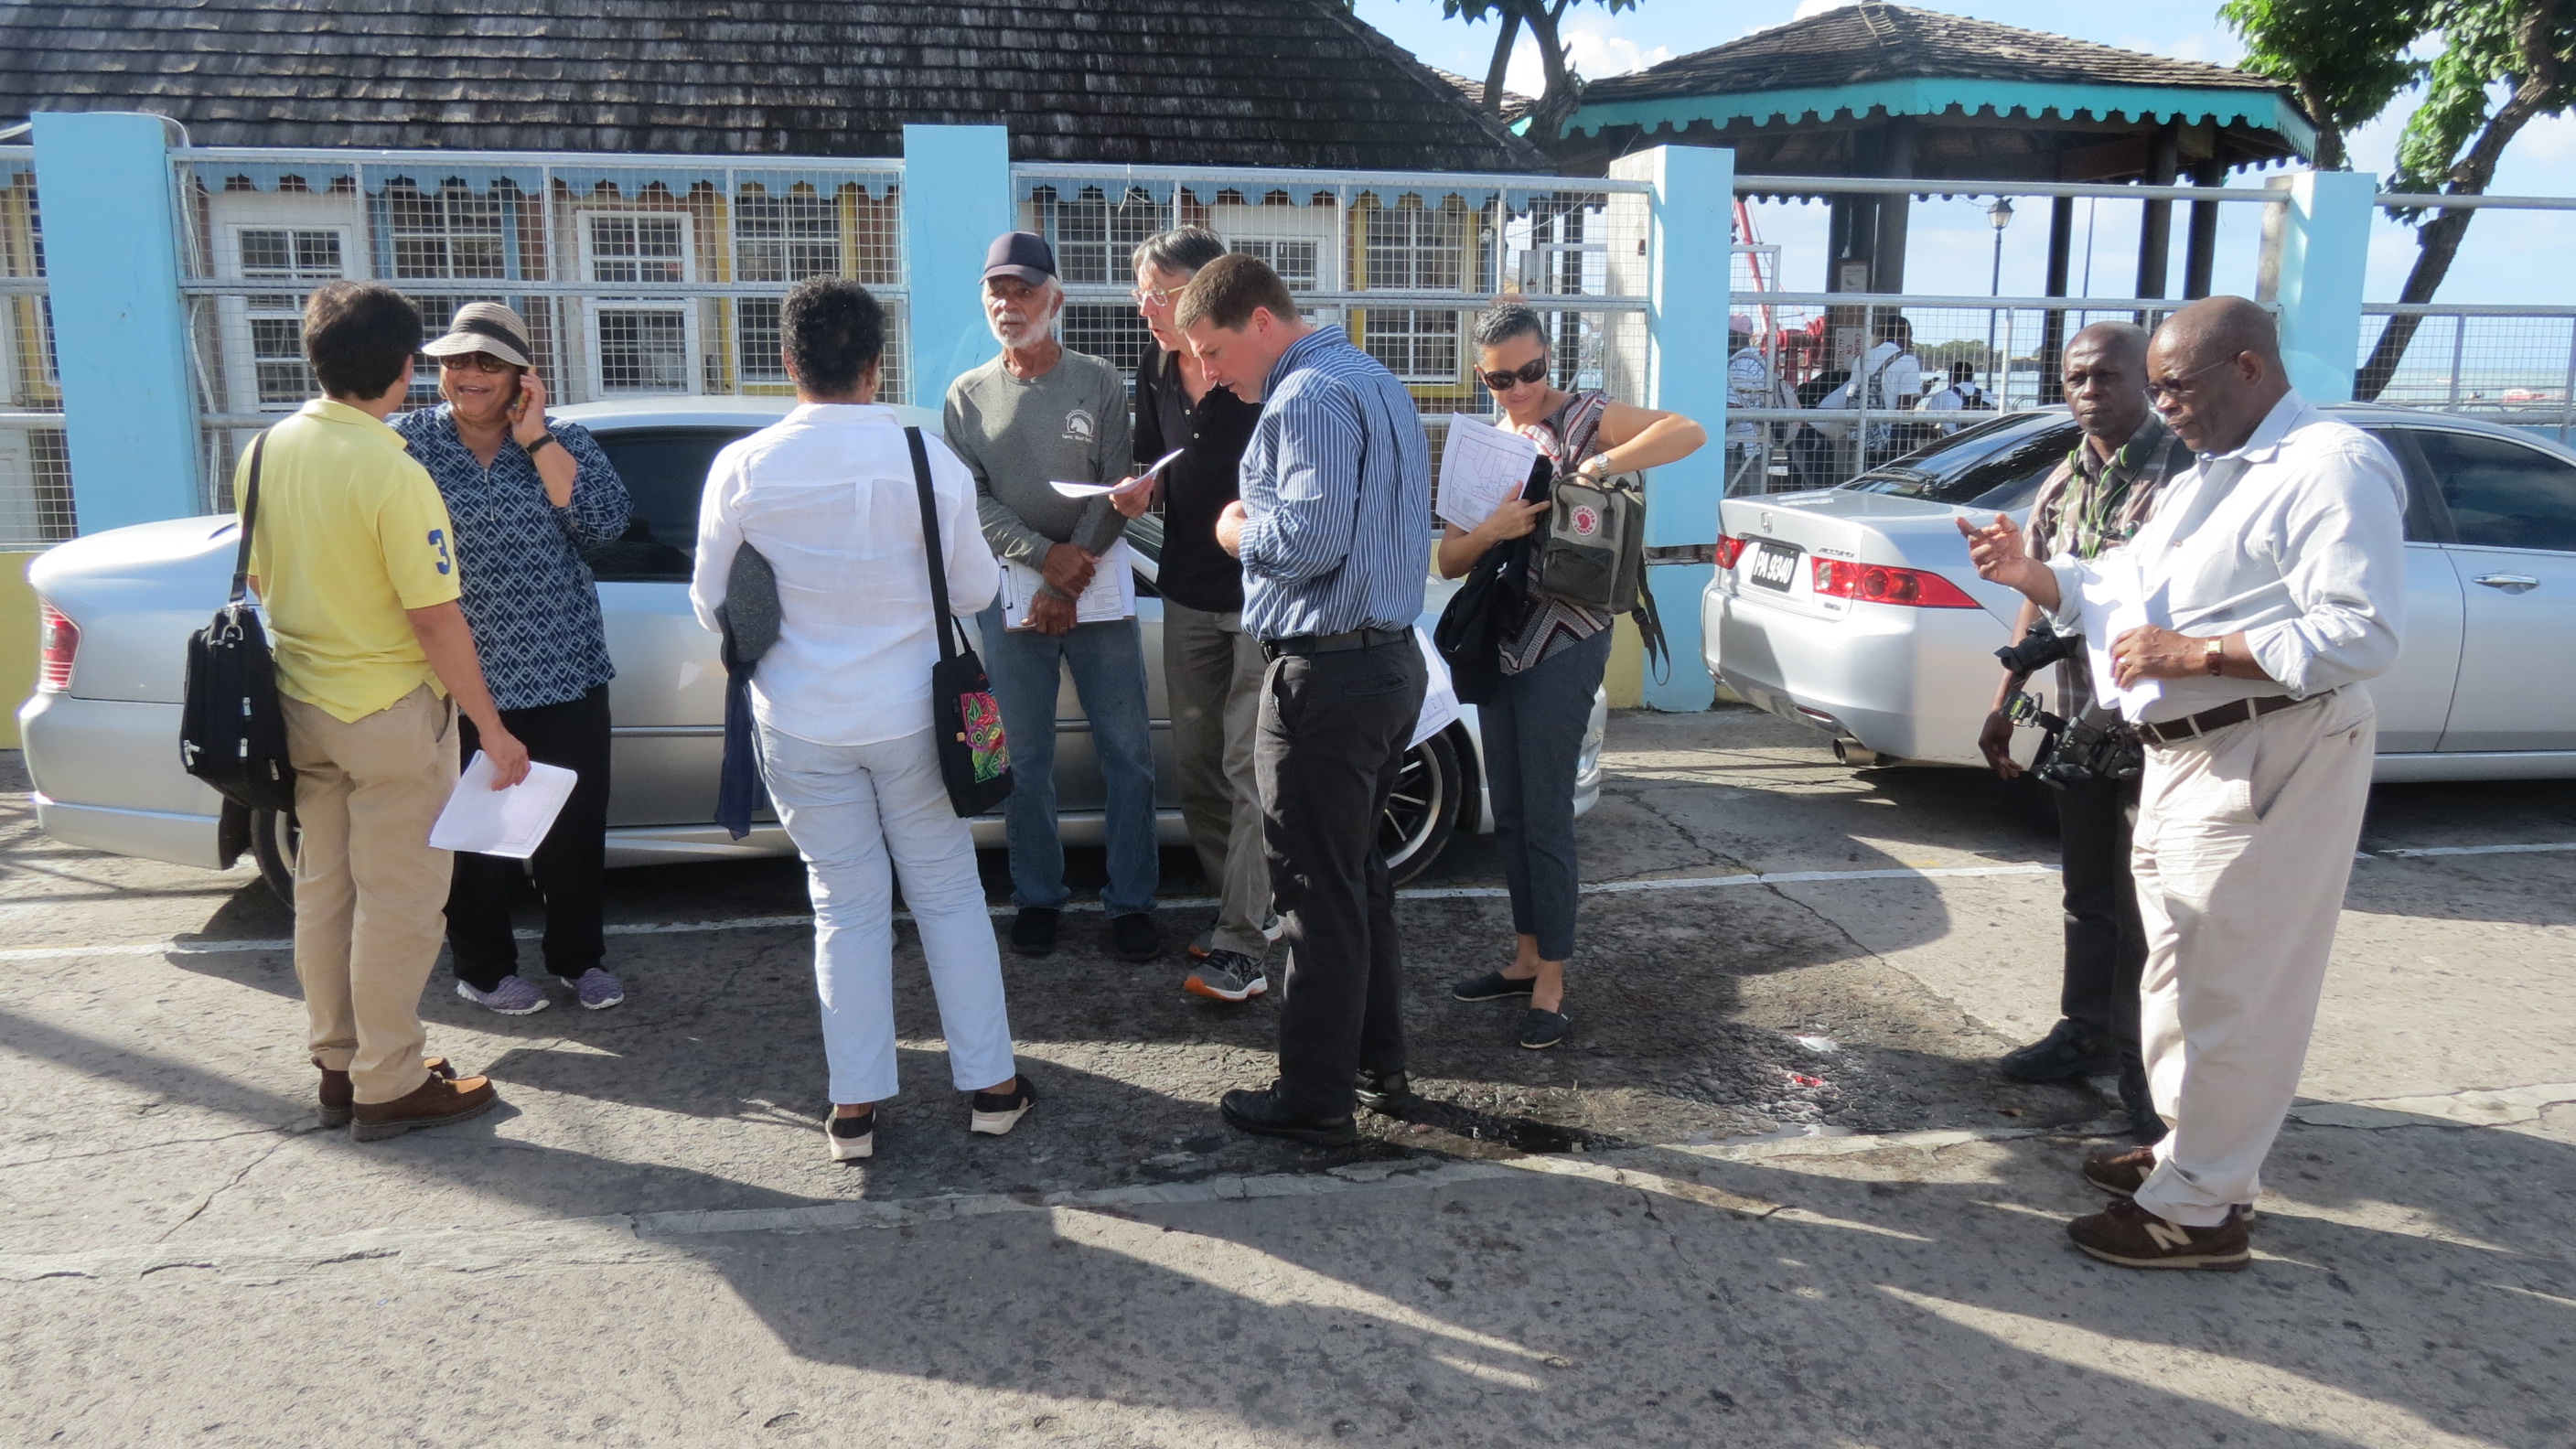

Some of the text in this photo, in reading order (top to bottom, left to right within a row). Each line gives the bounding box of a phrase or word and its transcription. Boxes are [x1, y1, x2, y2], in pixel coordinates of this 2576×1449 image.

[428, 529, 451, 575] 3
[1754, 551, 1795, 585] PA 9340
[2143, 1220, 2192, 1250] N
